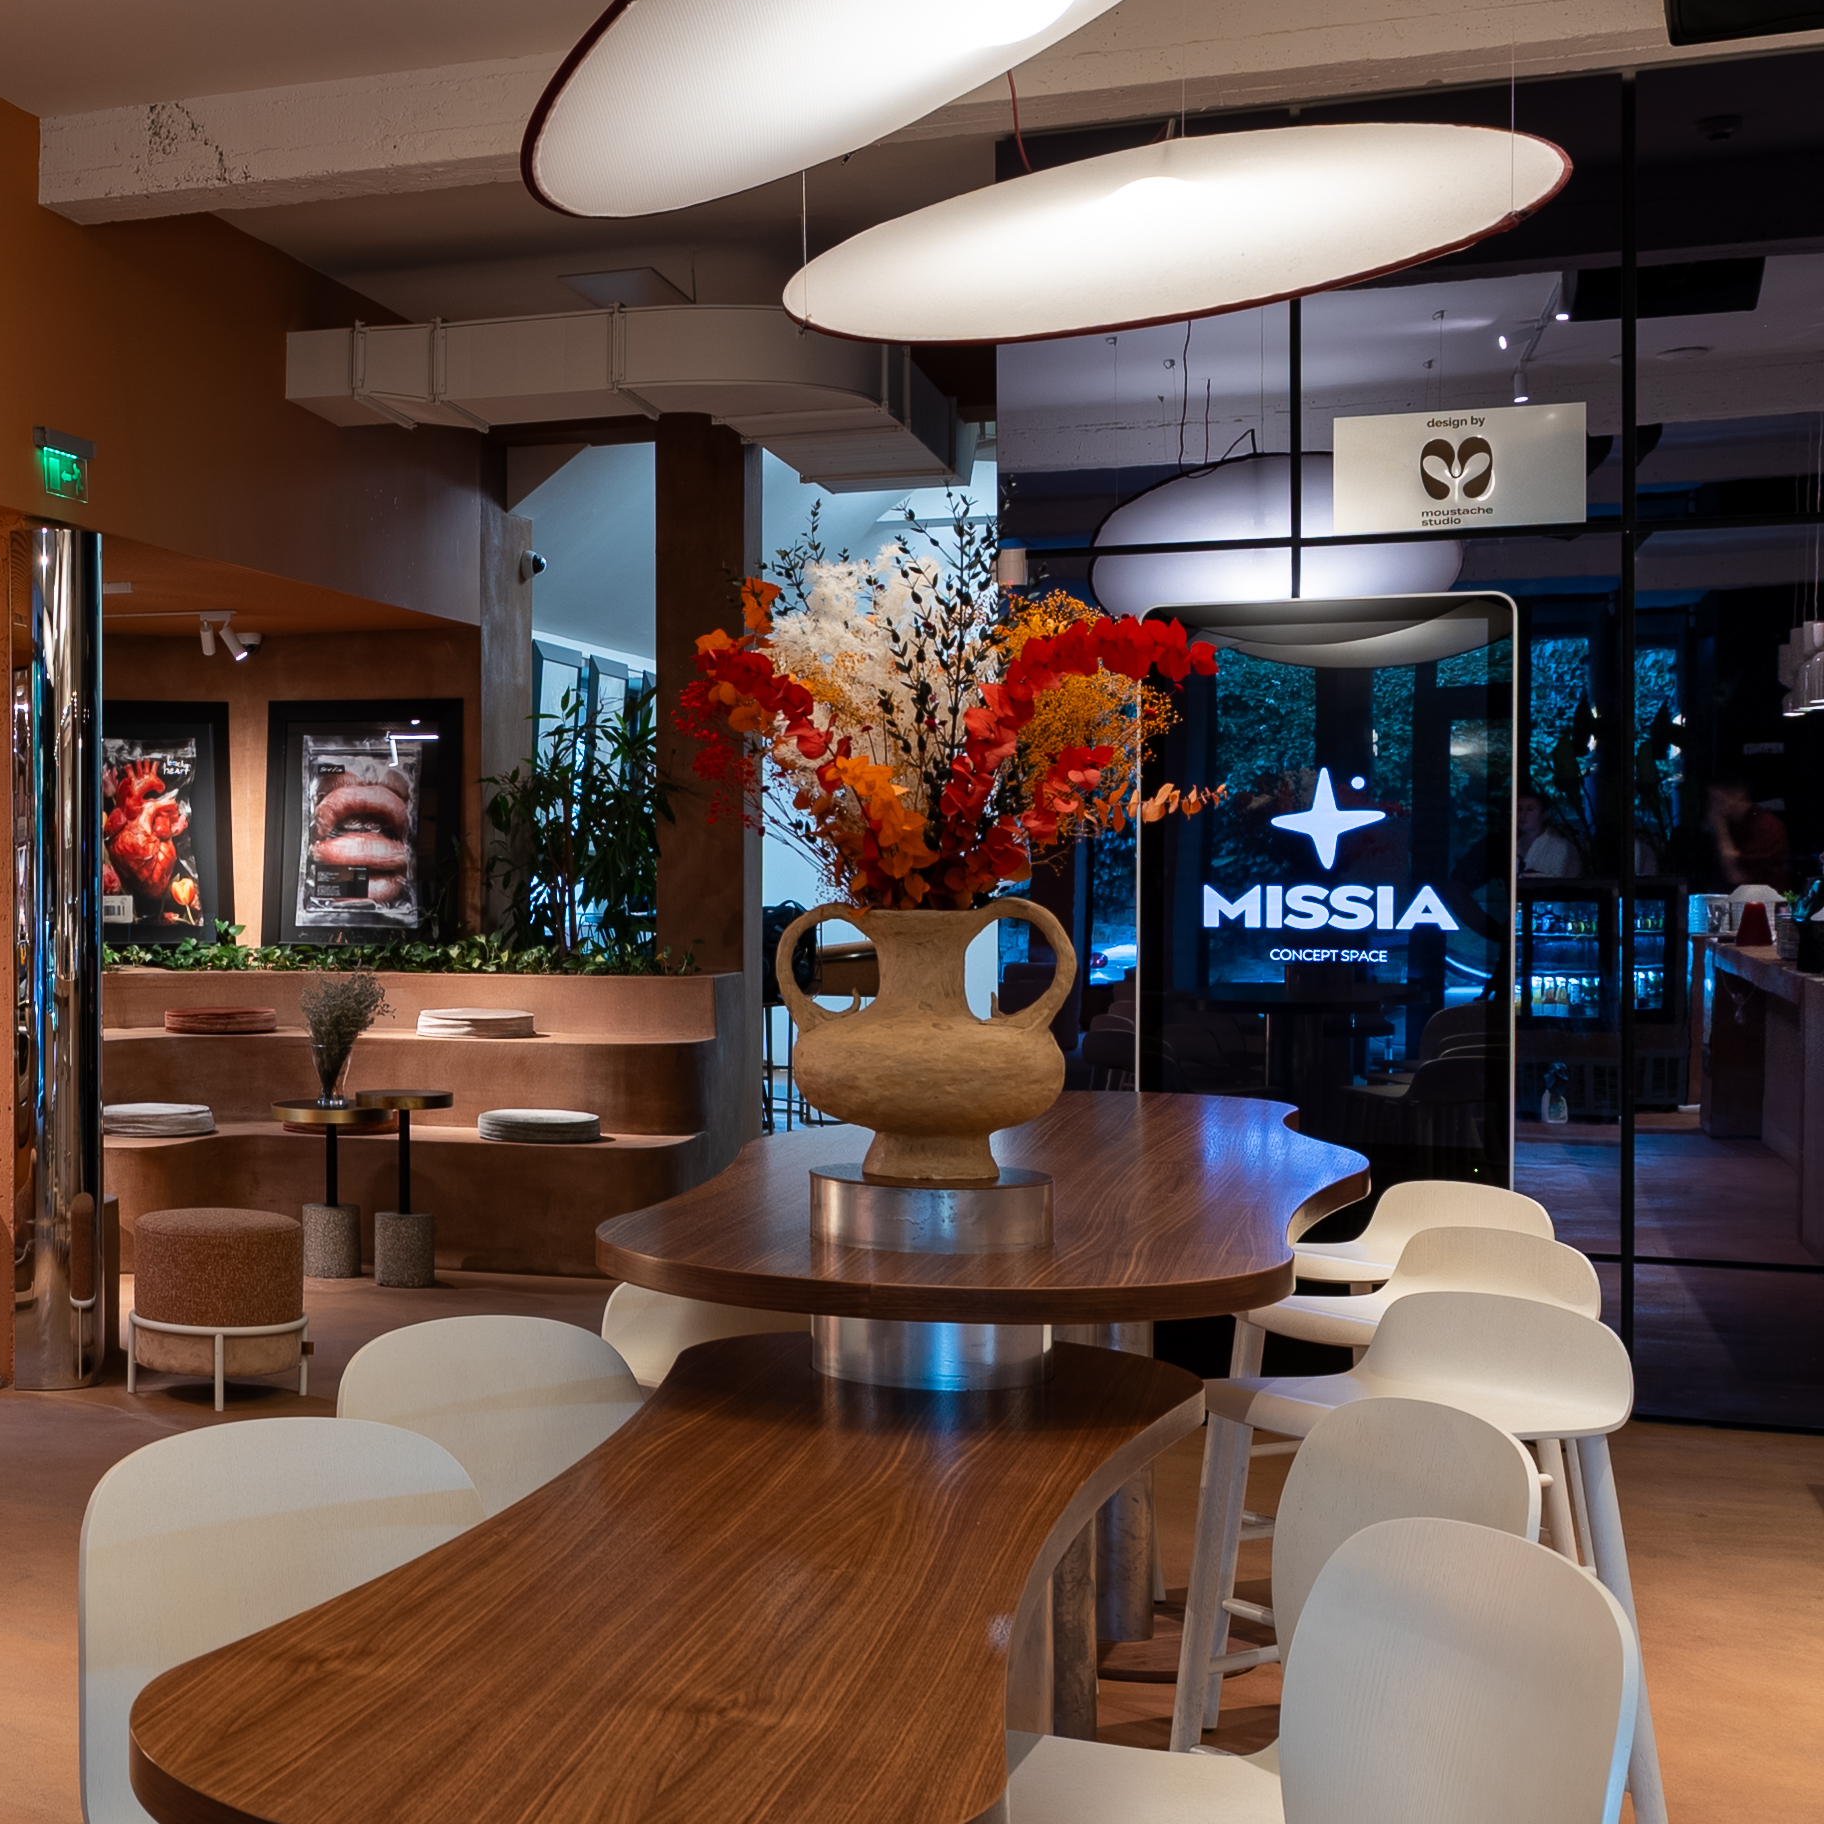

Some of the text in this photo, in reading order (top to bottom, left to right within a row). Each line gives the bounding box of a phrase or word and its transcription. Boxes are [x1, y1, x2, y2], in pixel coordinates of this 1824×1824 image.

[1426, 415, 1486, 429] design by
[1421, 506, 1494, 518] moustache
[1421, 516, 1462, 527] studio
[1203, 884, 1460, 931] MISSIA
[1269, 949, 1388, 963] CONCEPT SPACE
